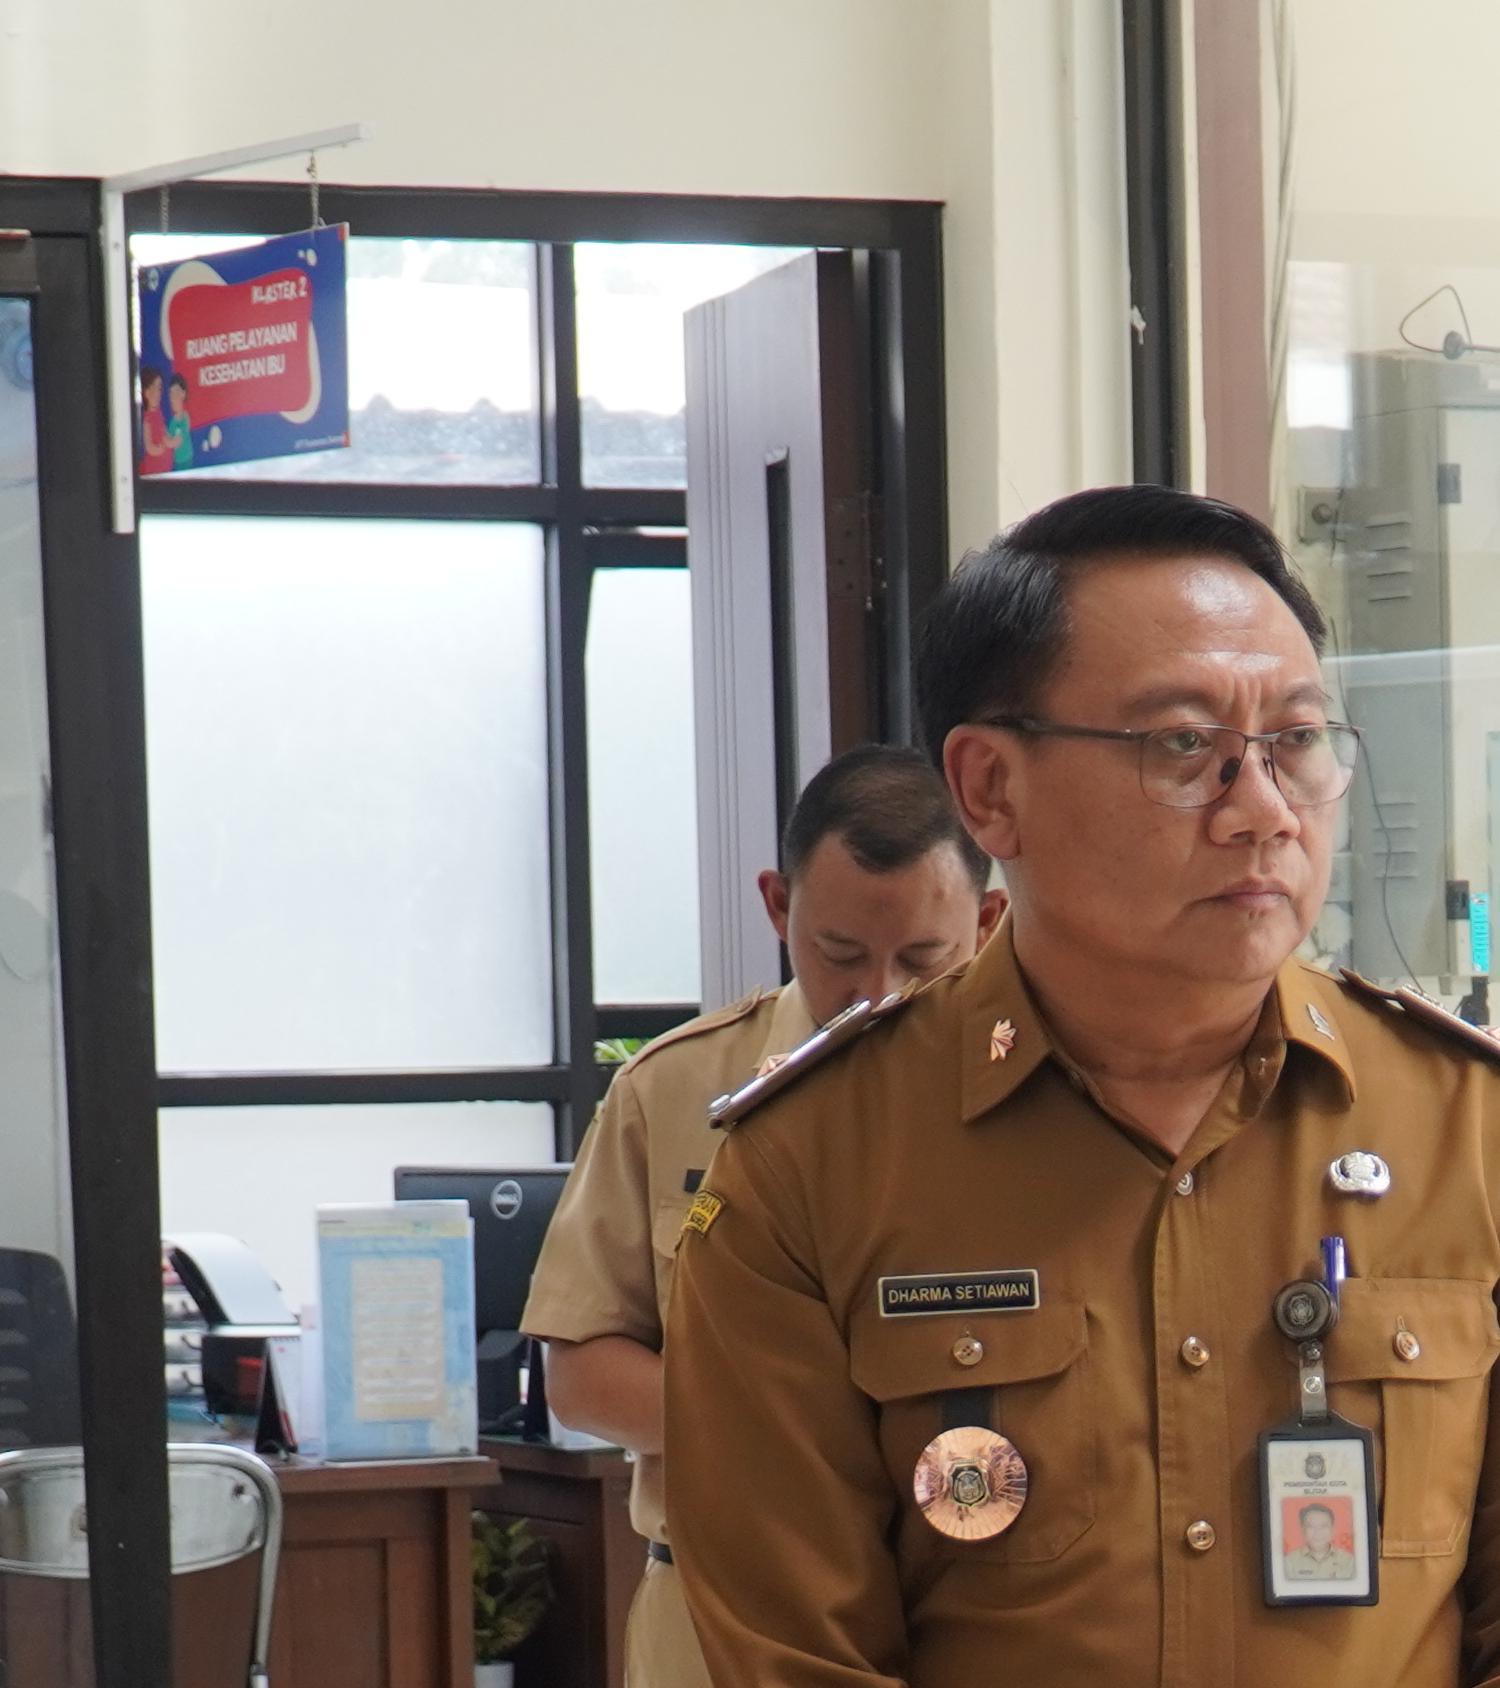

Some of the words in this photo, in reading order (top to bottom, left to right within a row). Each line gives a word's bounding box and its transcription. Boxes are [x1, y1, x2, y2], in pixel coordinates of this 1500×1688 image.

[186, 333, 228, 360] RUANG
[229, 321, 298, 350] PELAYANAN
[199, 357, 265, 387] KESEHATAN
[267, 353, 286, 375] IBU
[888, 1286, 952, 1304] DHARMA
[955, 1282, 1030, 1300] SETIAWAN
